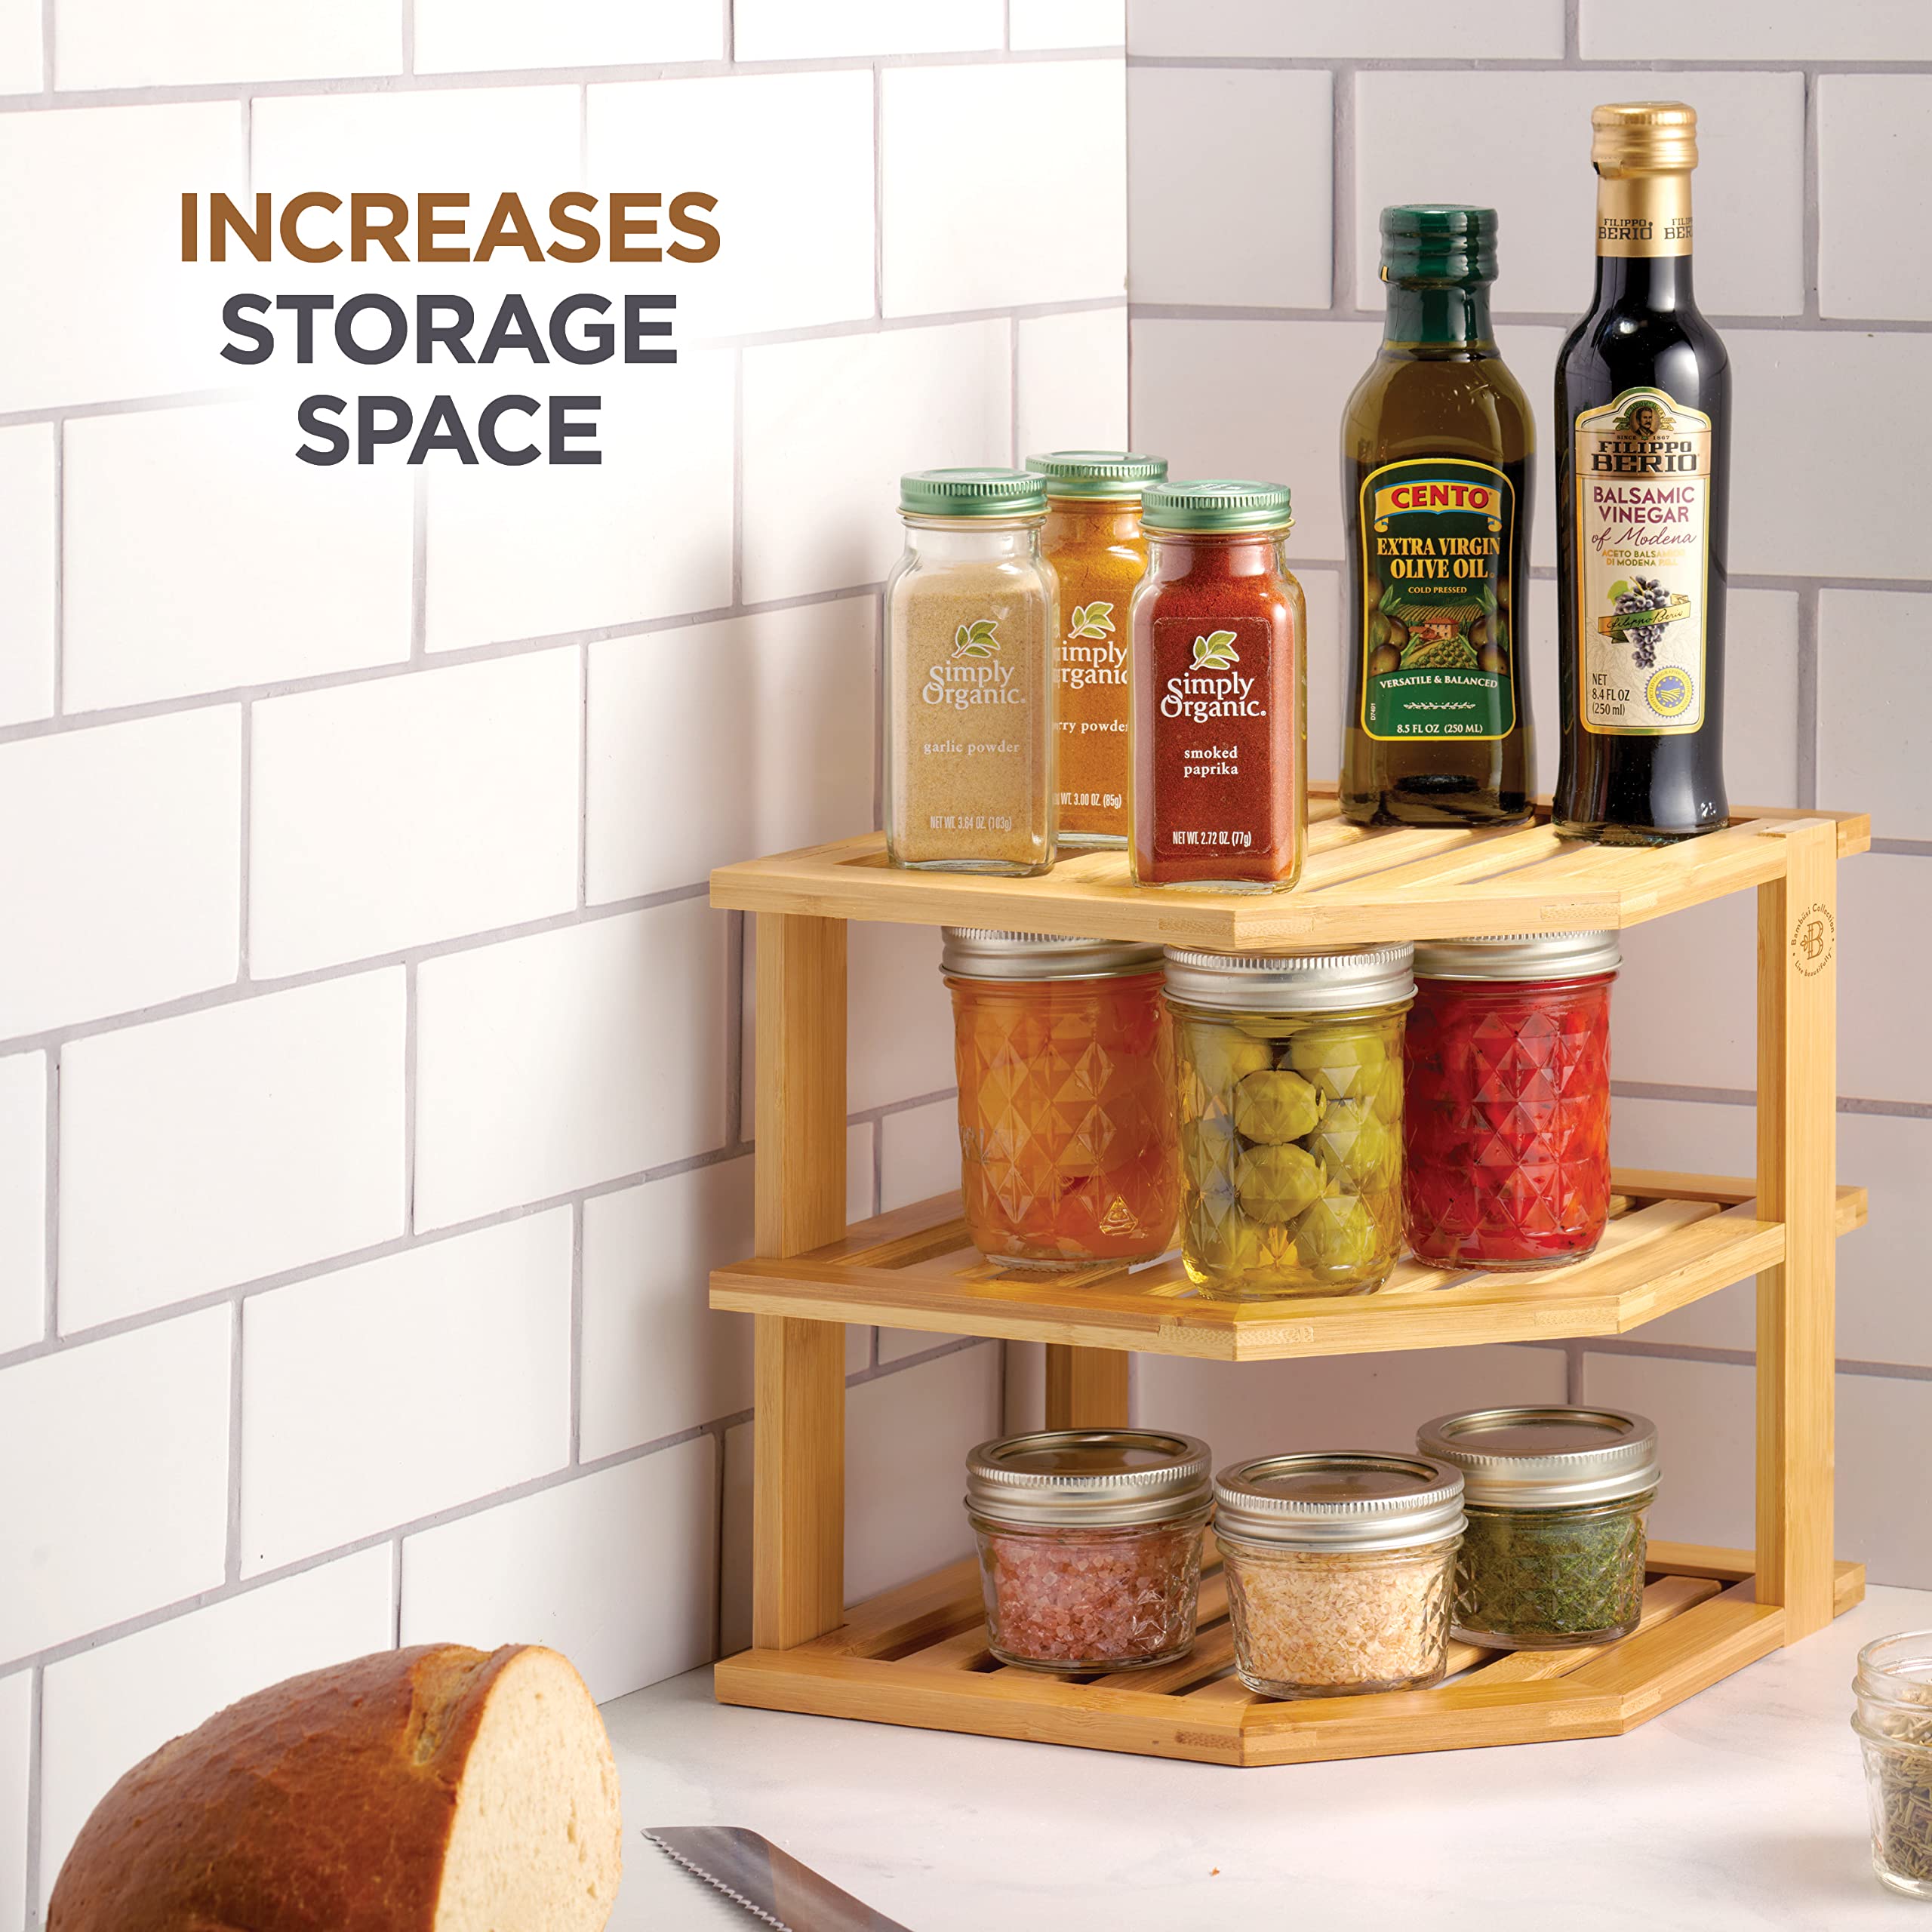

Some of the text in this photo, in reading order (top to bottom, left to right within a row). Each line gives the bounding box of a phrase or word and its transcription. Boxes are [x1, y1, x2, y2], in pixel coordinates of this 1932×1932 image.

[1604, 218, 1647, 226] FILIPPO
[1598, 227, 1652, 240] BERIO
[1598, 441, 1692, 454] FILIPPO
[1591, 453, 1697, 472] BERIO
[1391, 485, 1489, 509] CENTO
[1593, 486, 1695, 504] BALSAMIC
[1598, 506, 1689, 524] VINEGAR
[1377, 537, 1501, 555] EXTRA VIRGIN
[1592, 526, 1697, 552] of Modena
[1601, 549, 1632, 558] ACETO
[1390, 558, 1488, 579] OLIVE OIL
[1606, 558, 1615, 566] DI
[1061, 640, 1128, 669] imply
[930, 660, 1015, 688] Simply
[1592, 673, 1607, 685] NET
[1168, 671, 1255, 700] Simply
[1380, 675, 1498, 689] VERSATILE & BALANCED
[1592, 688, 1630, 701] 8.4 FL OZ
[1592, 702, 1625, 715] (250 ml)
[1397, 724, 1483, 734] 8.5 FL OZ (250 ML)
[924, 740, 1020, 755] garlic powder
[1184, 746, 1238, 758] smoked
[1184, 762, 1238, 777] paprika
[1074, 793, 1089, 805] 3.00
[1091, 793, 1101, 806] OZ.
[1103, 794, 1121, 809] (85g)
[931, 816, 943, 829] NET
[958, 817, 974, 829] 3.64
[976, 817, 986, 829] OZ.
[988, 817, 1012, 832] (103g)
[1173, 831, 1186, 844] NET
[1201, 832, 1217, 844] 2.72
[1219, 832, 1230, 844] OZ.
[1232, 831, 1251, 847] (77g)
[1812, 903, 1835, 933] Collection
[1795, 959, 1804, 974] Live
